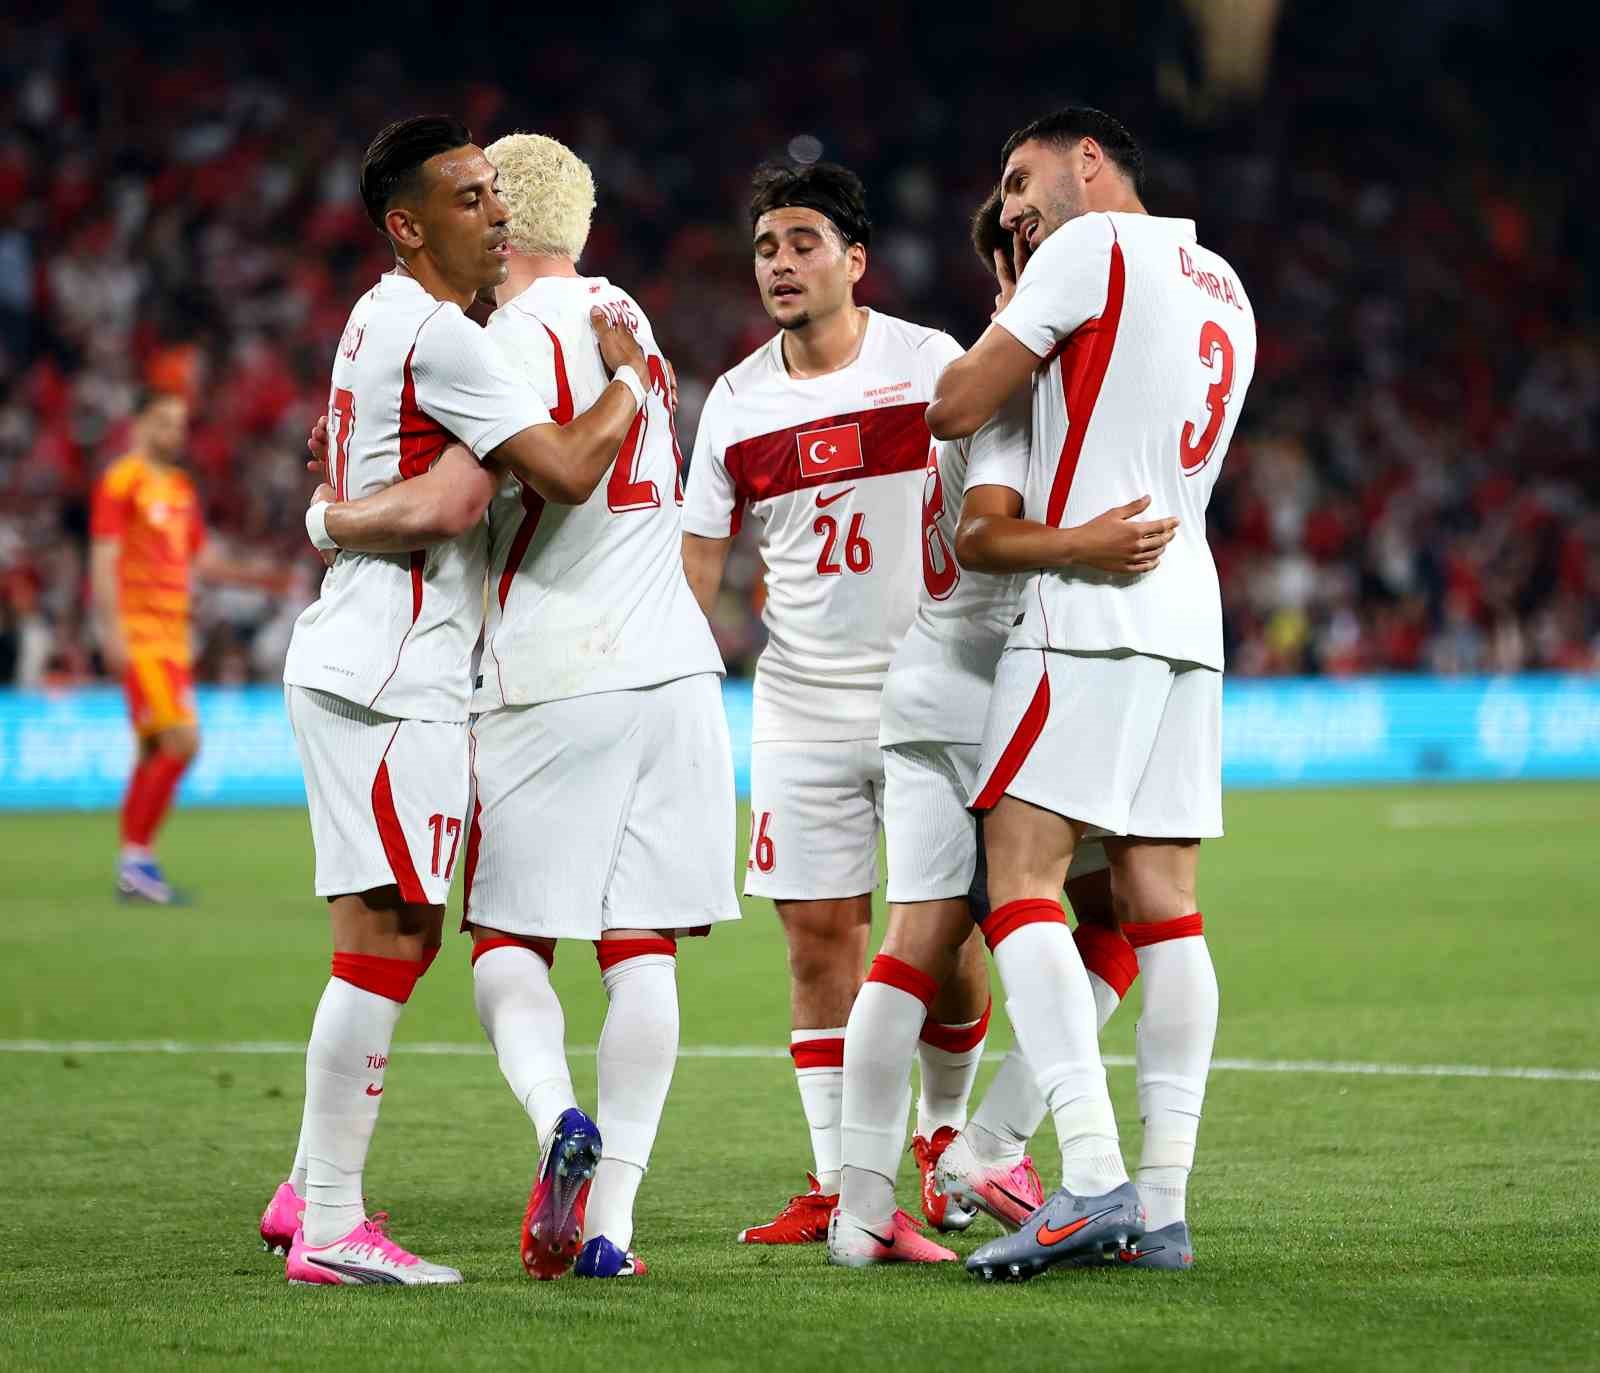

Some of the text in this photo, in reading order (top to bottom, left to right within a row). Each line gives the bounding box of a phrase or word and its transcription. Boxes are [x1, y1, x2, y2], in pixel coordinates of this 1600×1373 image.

[1179, 320, 1237, 478] 3
[813, 511, 874, 577] 26
[428, 813, 462, 881] 17
